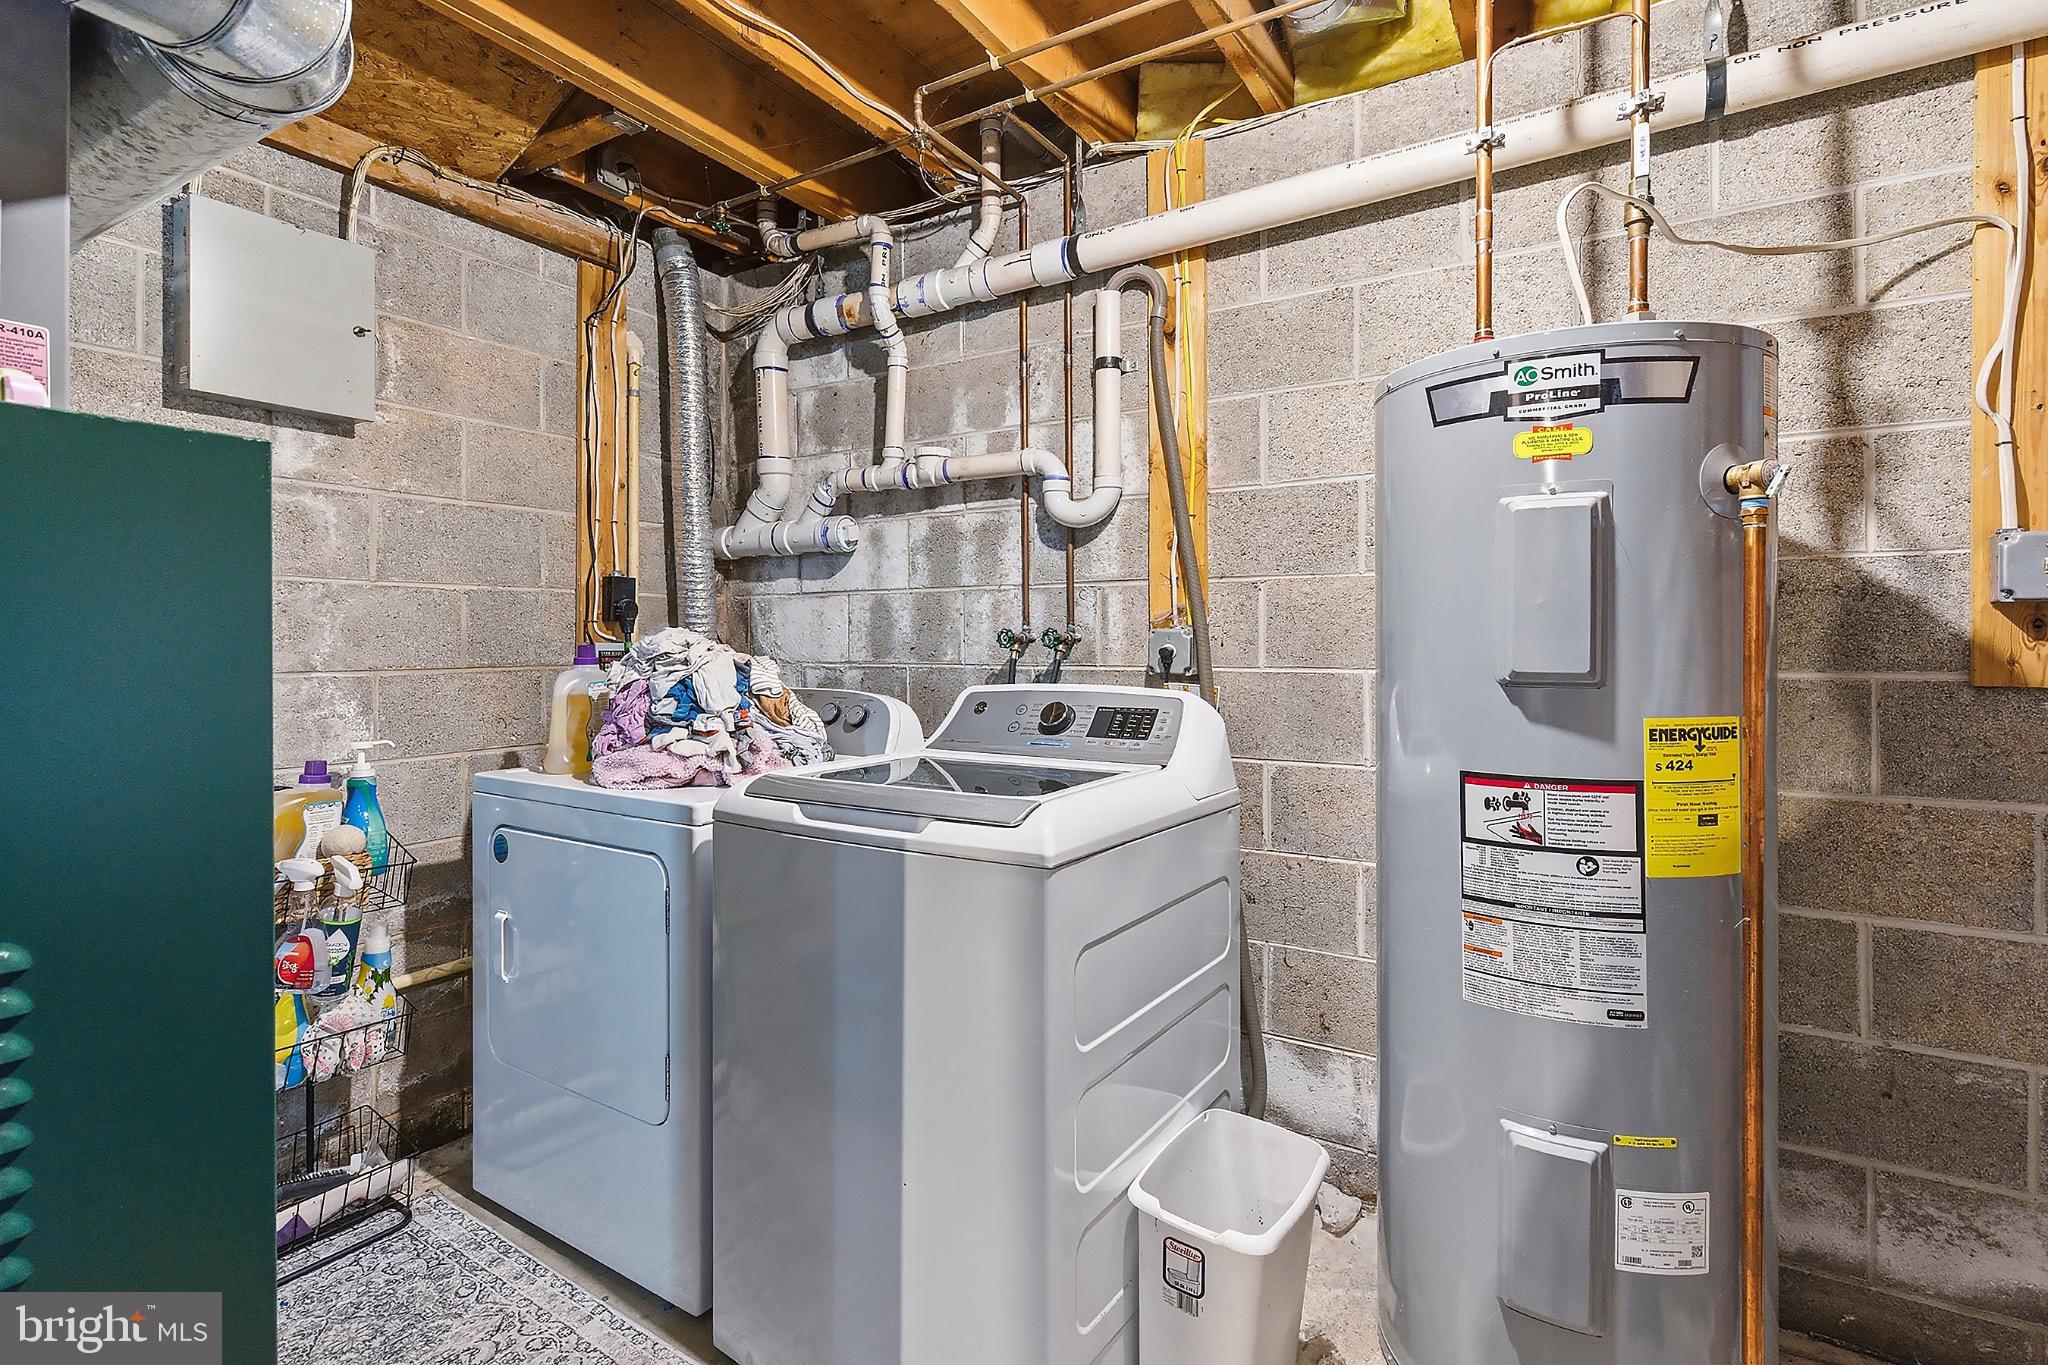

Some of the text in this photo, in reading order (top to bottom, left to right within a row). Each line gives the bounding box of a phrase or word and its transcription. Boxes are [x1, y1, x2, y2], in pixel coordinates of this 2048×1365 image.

[1734, 53, 1760, 64] OR
[1777, 36, 1822, 53] NON
[1084, 227, 1115, 240] ONLY
[1525, 389, 1581, 401] ProLine
[1649, 726, 1738, 743] ENERGYGUIDE
[1665, 760, 1694, 771] 424
[1533, 783, 1569, 791] DANGER
